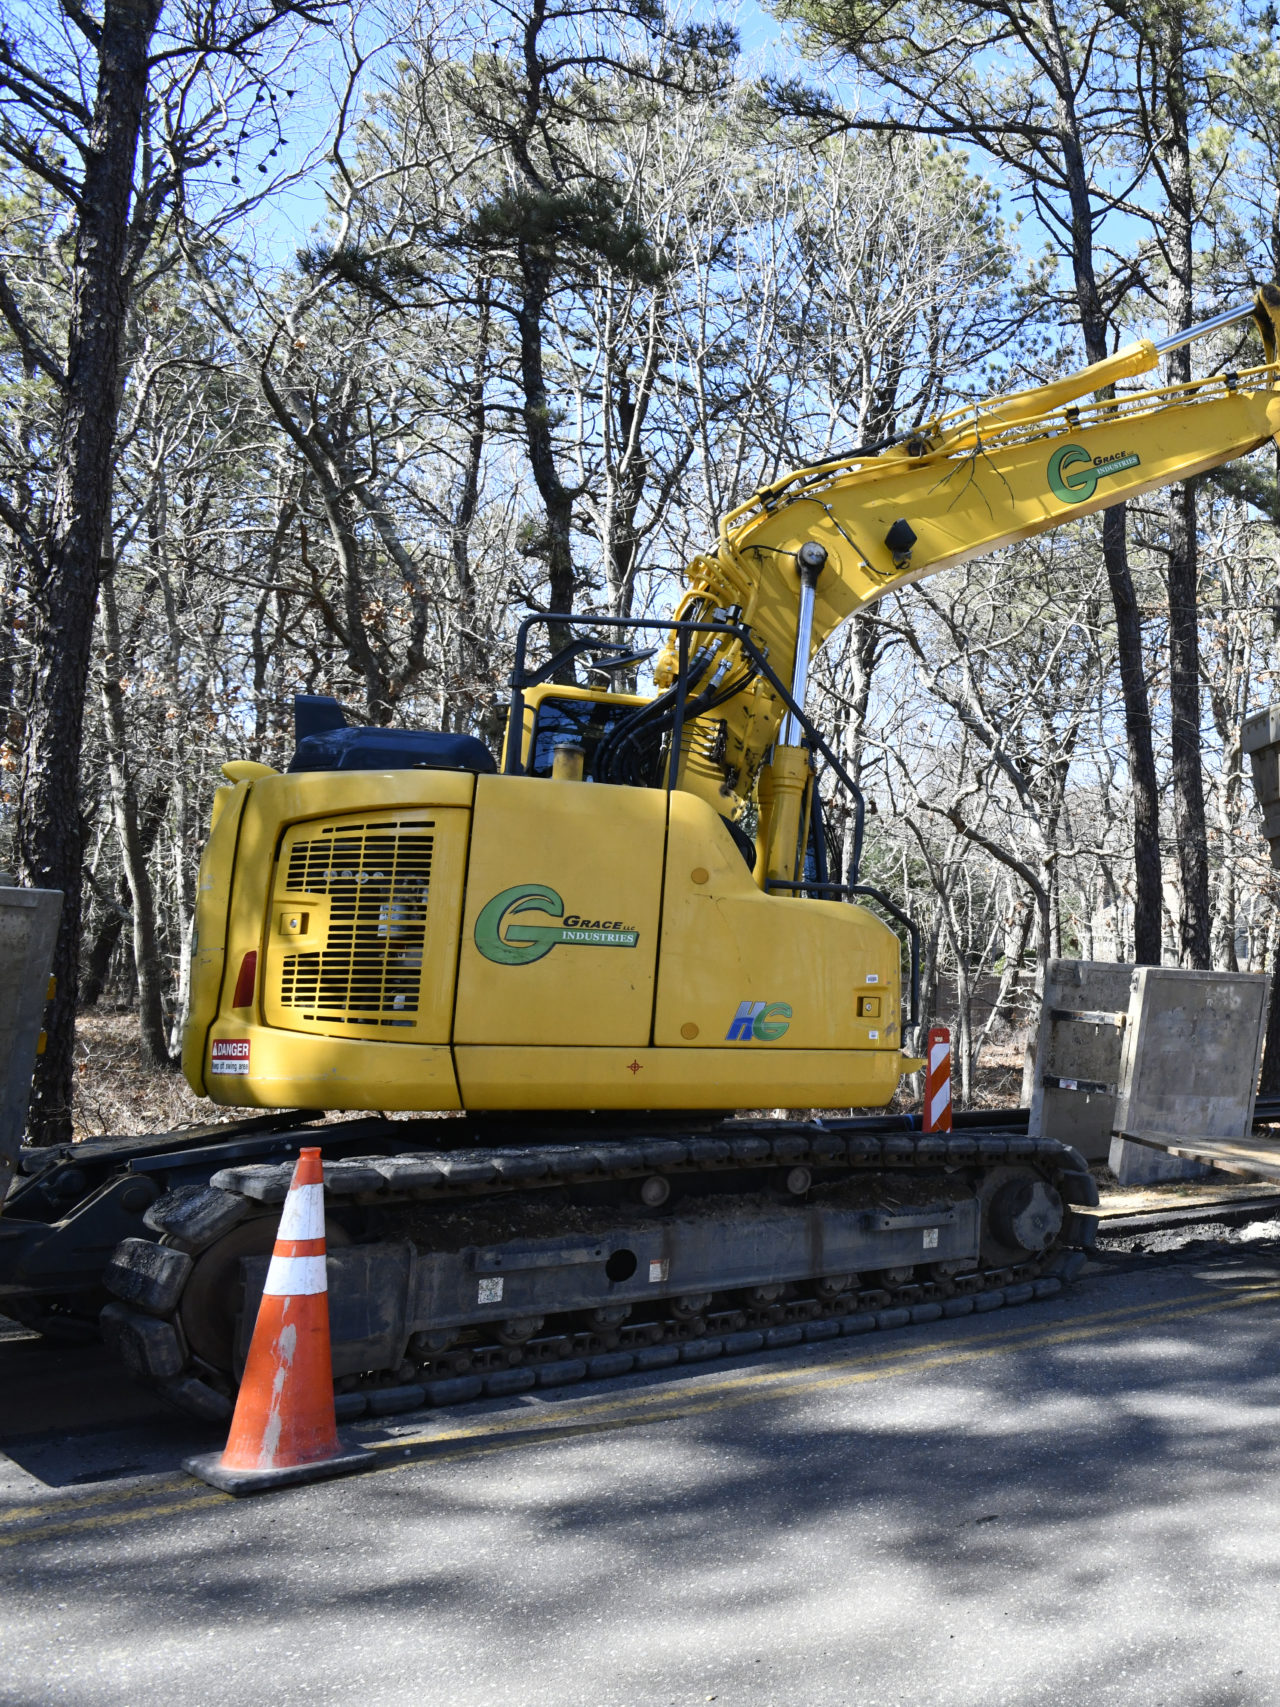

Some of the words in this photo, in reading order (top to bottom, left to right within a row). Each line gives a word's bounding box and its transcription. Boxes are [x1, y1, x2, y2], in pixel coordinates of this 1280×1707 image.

[1096, 456, 1138, 475] INDUSTRIES
[562, 931, 634, 943] INDUSTRIES
[217, 1043, 249, 1056] DANGER
[225, 1061, 237, 1072] swing
